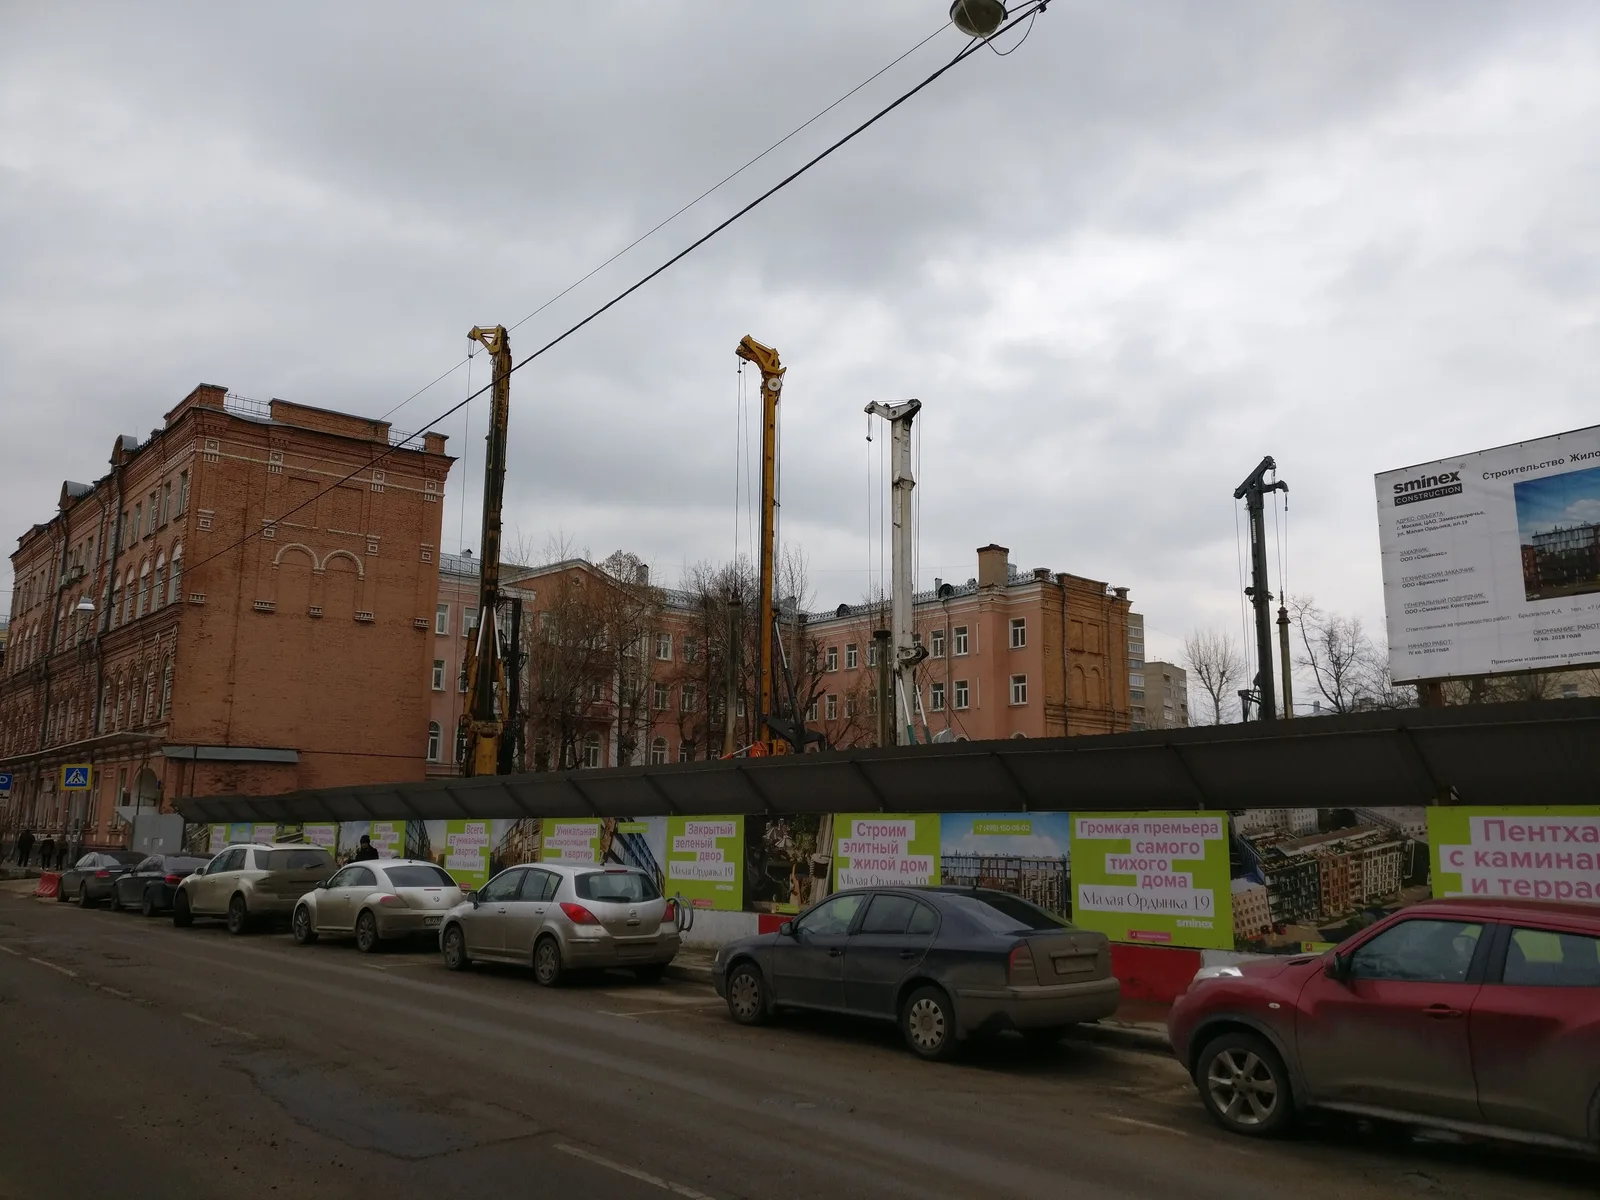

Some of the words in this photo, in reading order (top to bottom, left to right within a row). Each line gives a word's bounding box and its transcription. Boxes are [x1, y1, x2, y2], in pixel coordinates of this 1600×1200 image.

[1482, 458, 1565, 480] Строительство
[1393, 471, 1461, 494] sminex
[1396, 486, 1461, 504] CONSTRUCTION
[466, 824, 483, 834] Всего
[556, 826, 597, 836] Уникальная
[687, 823, 733, 836] Закрытый
[856, 822, 906, 839] Строим
[1080, 821, 1139, 836] Громкая
[1144, 822, 1219, 837] премьера
[675, 837, 713, 849] зеленый
[843, 840, 899, 855] элитный
[1136, 842, 1200, 855] самого
[454, 849, 478, 858] квартир
[564, 850, 592, 860] квартир
[700, 851, 722, 862] двор
[1449, 850, 1465, 867] с
[1474, 850, 1600, 870] камина
[724, 867, 733, 877] 19
[853, 856, 896, 872] жилой
[900, 859, 928, 875] дом
[1110, 858, 1168, 872] тихого
[841, 873, 868, 886] Малая
[1141, 875, 1188, 889] дома
[1471, 878, 1489, 895] и
[1083, 891, 1124, 907] Малая
[1127, 892, 1188, 911] Ордынка
[1193, 895, 1210, 910] 19
[1176, 918, 1214, 929] sminex
